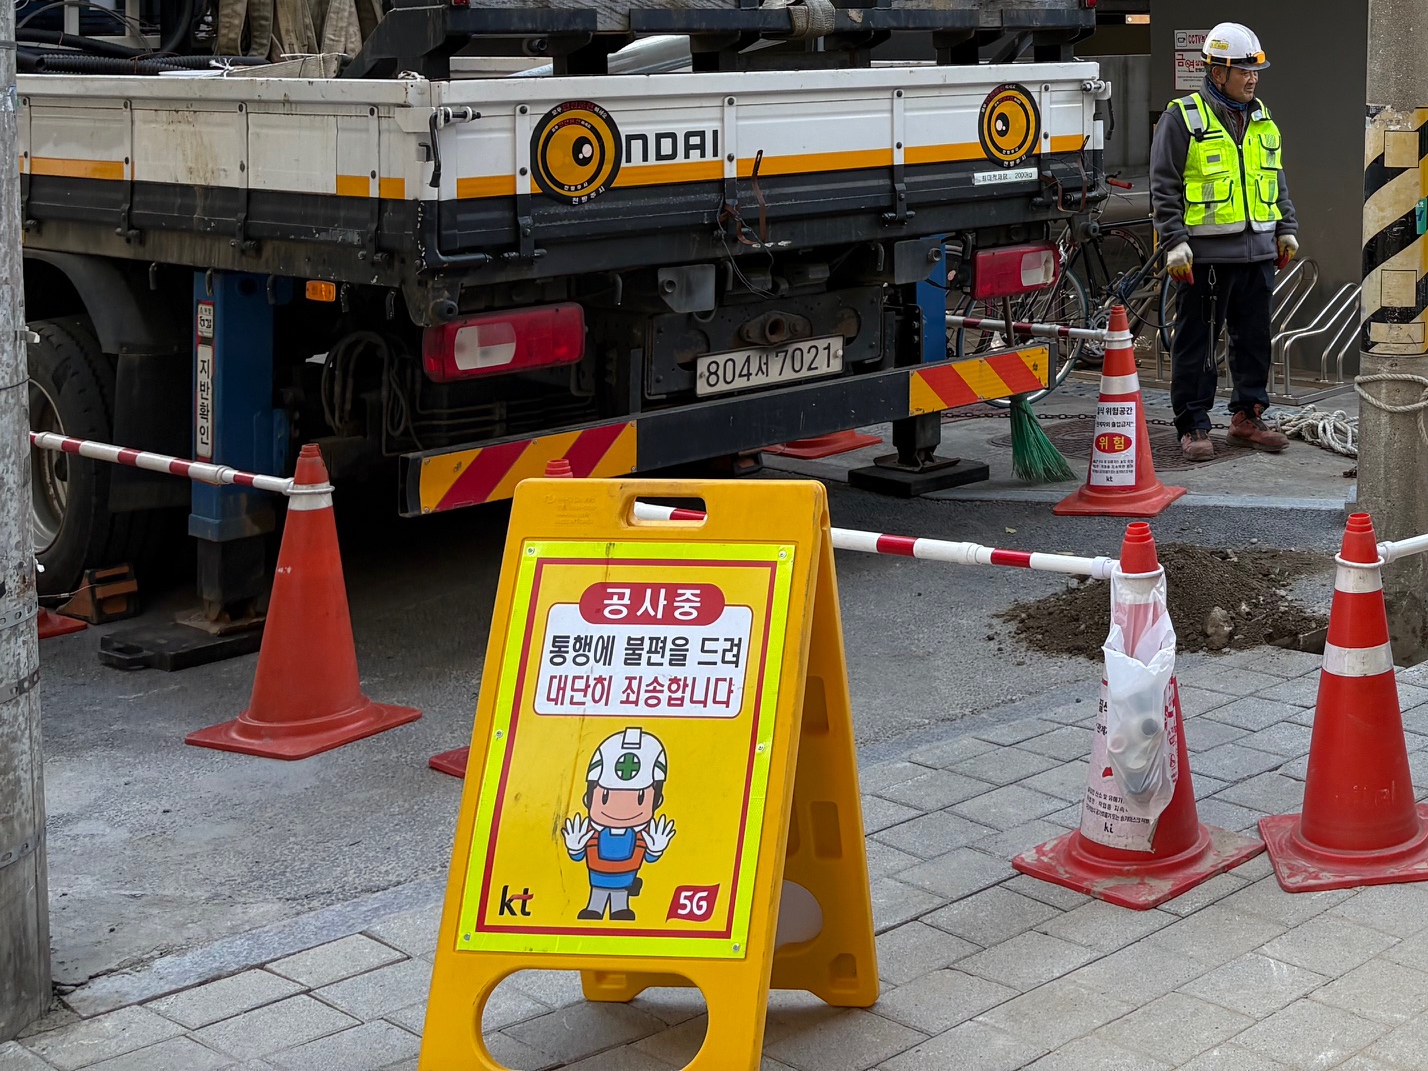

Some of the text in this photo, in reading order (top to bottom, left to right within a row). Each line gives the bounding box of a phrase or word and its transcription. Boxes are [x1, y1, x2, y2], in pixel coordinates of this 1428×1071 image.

[706, 342, 832, 388] 804서 7021
[1099, 435, 1125, 450] 위험
[602, 588, 702, 620] 공사중
[549, 634, 743, 668] 통행에 불편을 드려
[546, 674, 735, 709] 대단히 죄송합니다
[498, 885, 709, 917] kt 5G
